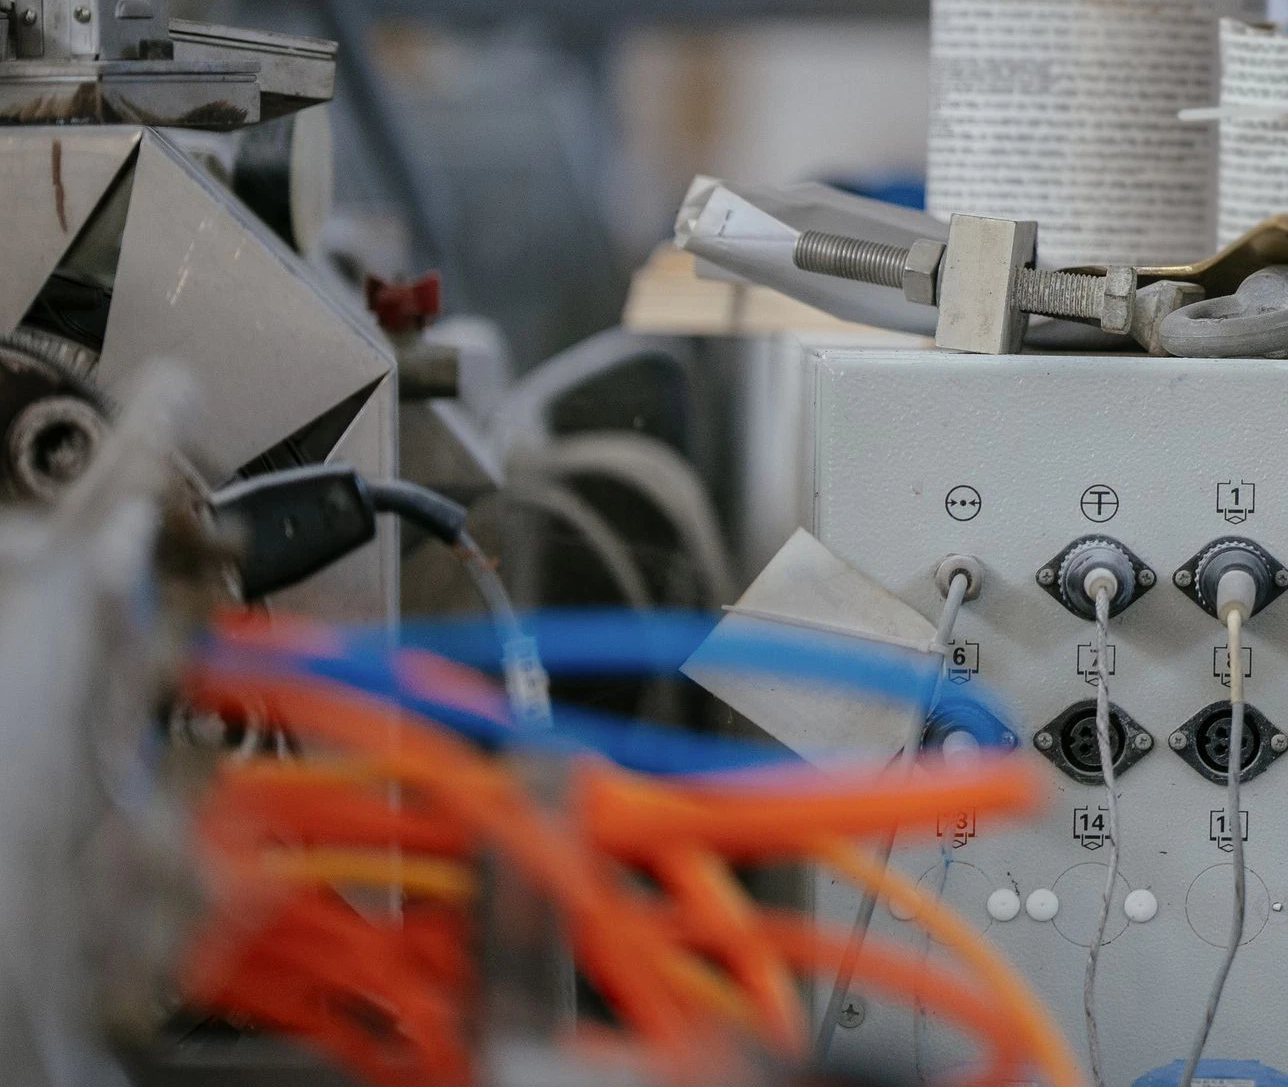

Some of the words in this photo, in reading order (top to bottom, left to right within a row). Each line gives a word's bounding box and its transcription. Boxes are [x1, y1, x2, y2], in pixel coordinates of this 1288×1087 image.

[1230, 488, 1239, 506] 1
[953, 647, 966, 666] 6
[1080, 813, 1105, 832] 14
